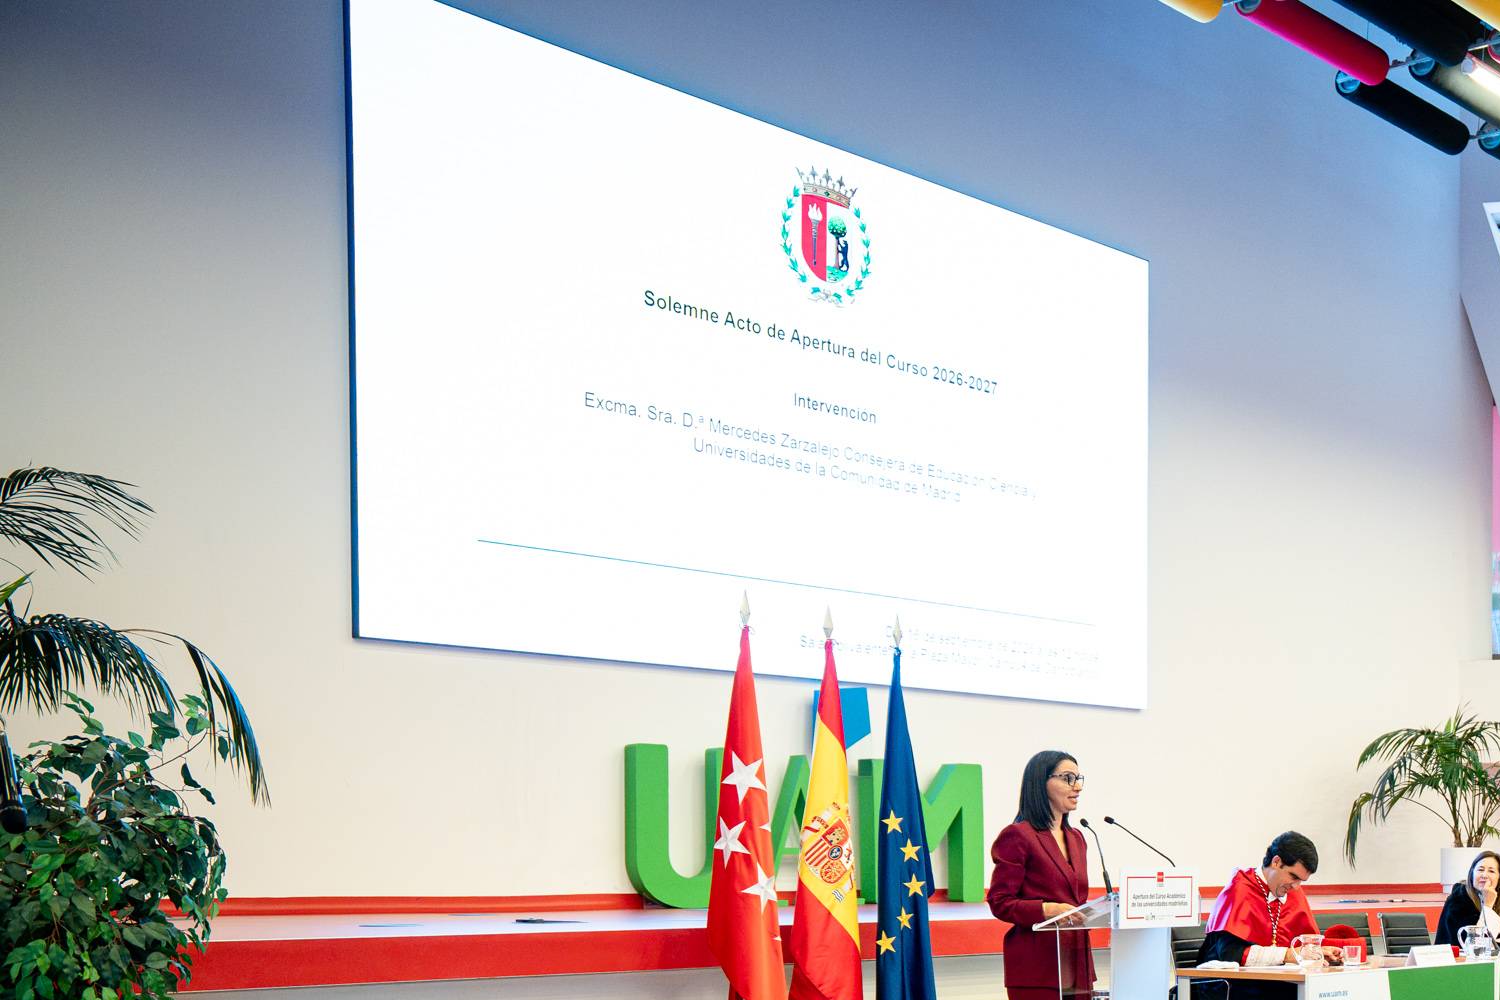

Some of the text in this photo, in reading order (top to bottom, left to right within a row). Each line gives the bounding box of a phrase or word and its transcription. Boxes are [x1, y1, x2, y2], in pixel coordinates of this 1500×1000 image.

[644, 290, 998, 395] Solemne Acto de Apertura del Curso 2026-2027
[584, 391, 641, 418] Excma.
[647, 405, 677, 425] Sra.
[709, 417, 776, 445] Mercedes
[780, 432, 839, 459] Zarzalejo
[693, 437, 790, 470] Universidades
[795, 458, 811, 474] de
[815, 461, 826, 477] la
